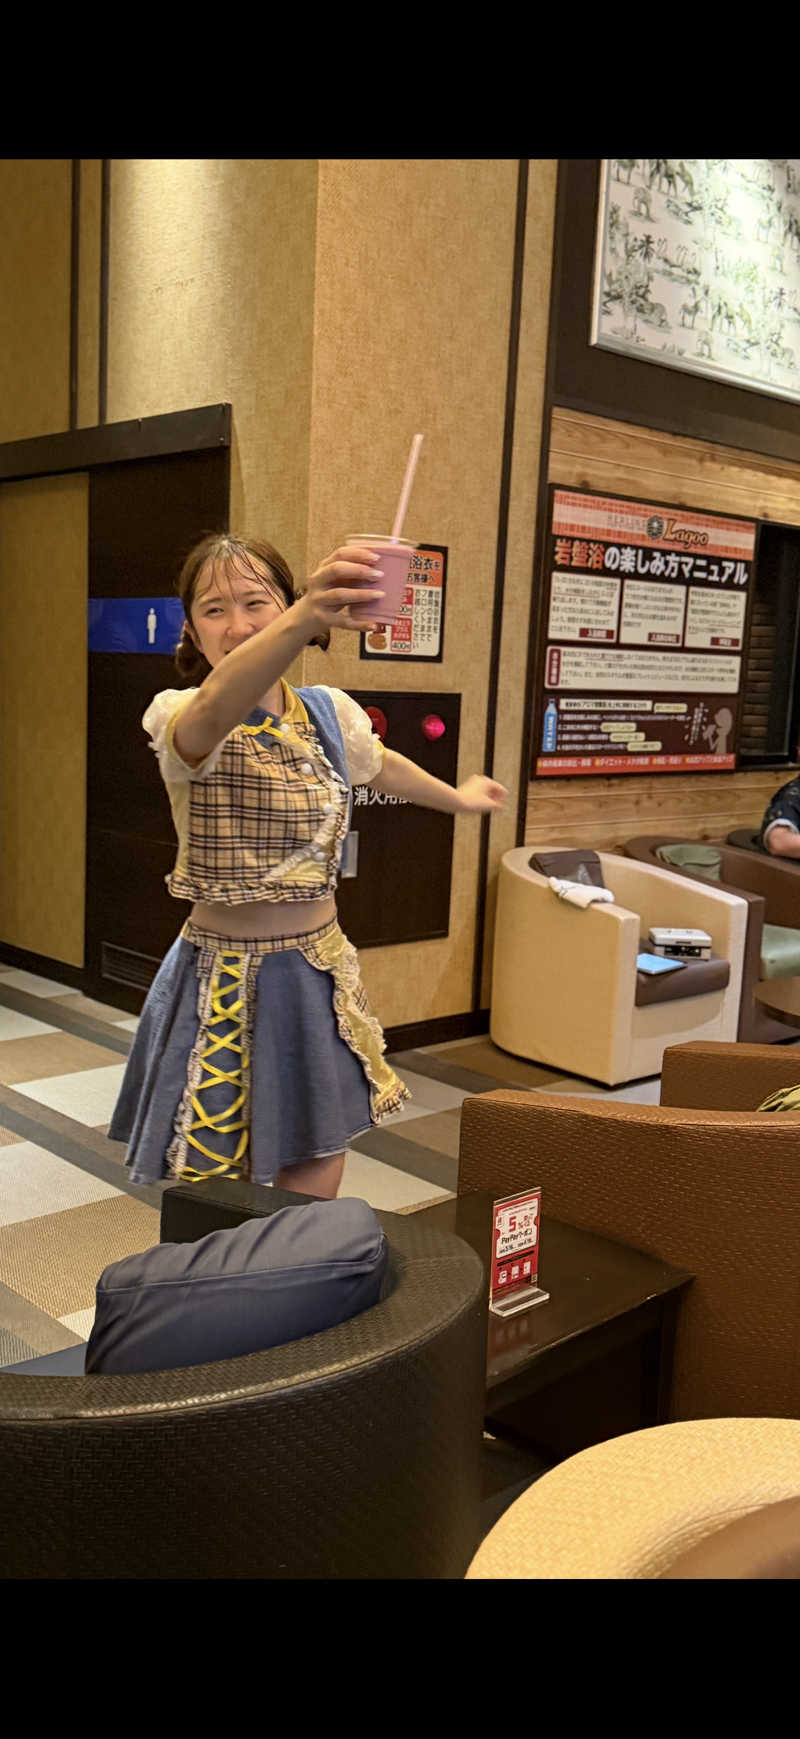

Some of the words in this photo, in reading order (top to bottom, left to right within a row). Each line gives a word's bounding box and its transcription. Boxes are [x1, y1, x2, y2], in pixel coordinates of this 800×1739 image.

[663, 519, 709, 549] Lagoo
[554, 539, 748, 585] 岩盤浴の楽しみ方マニュアル
